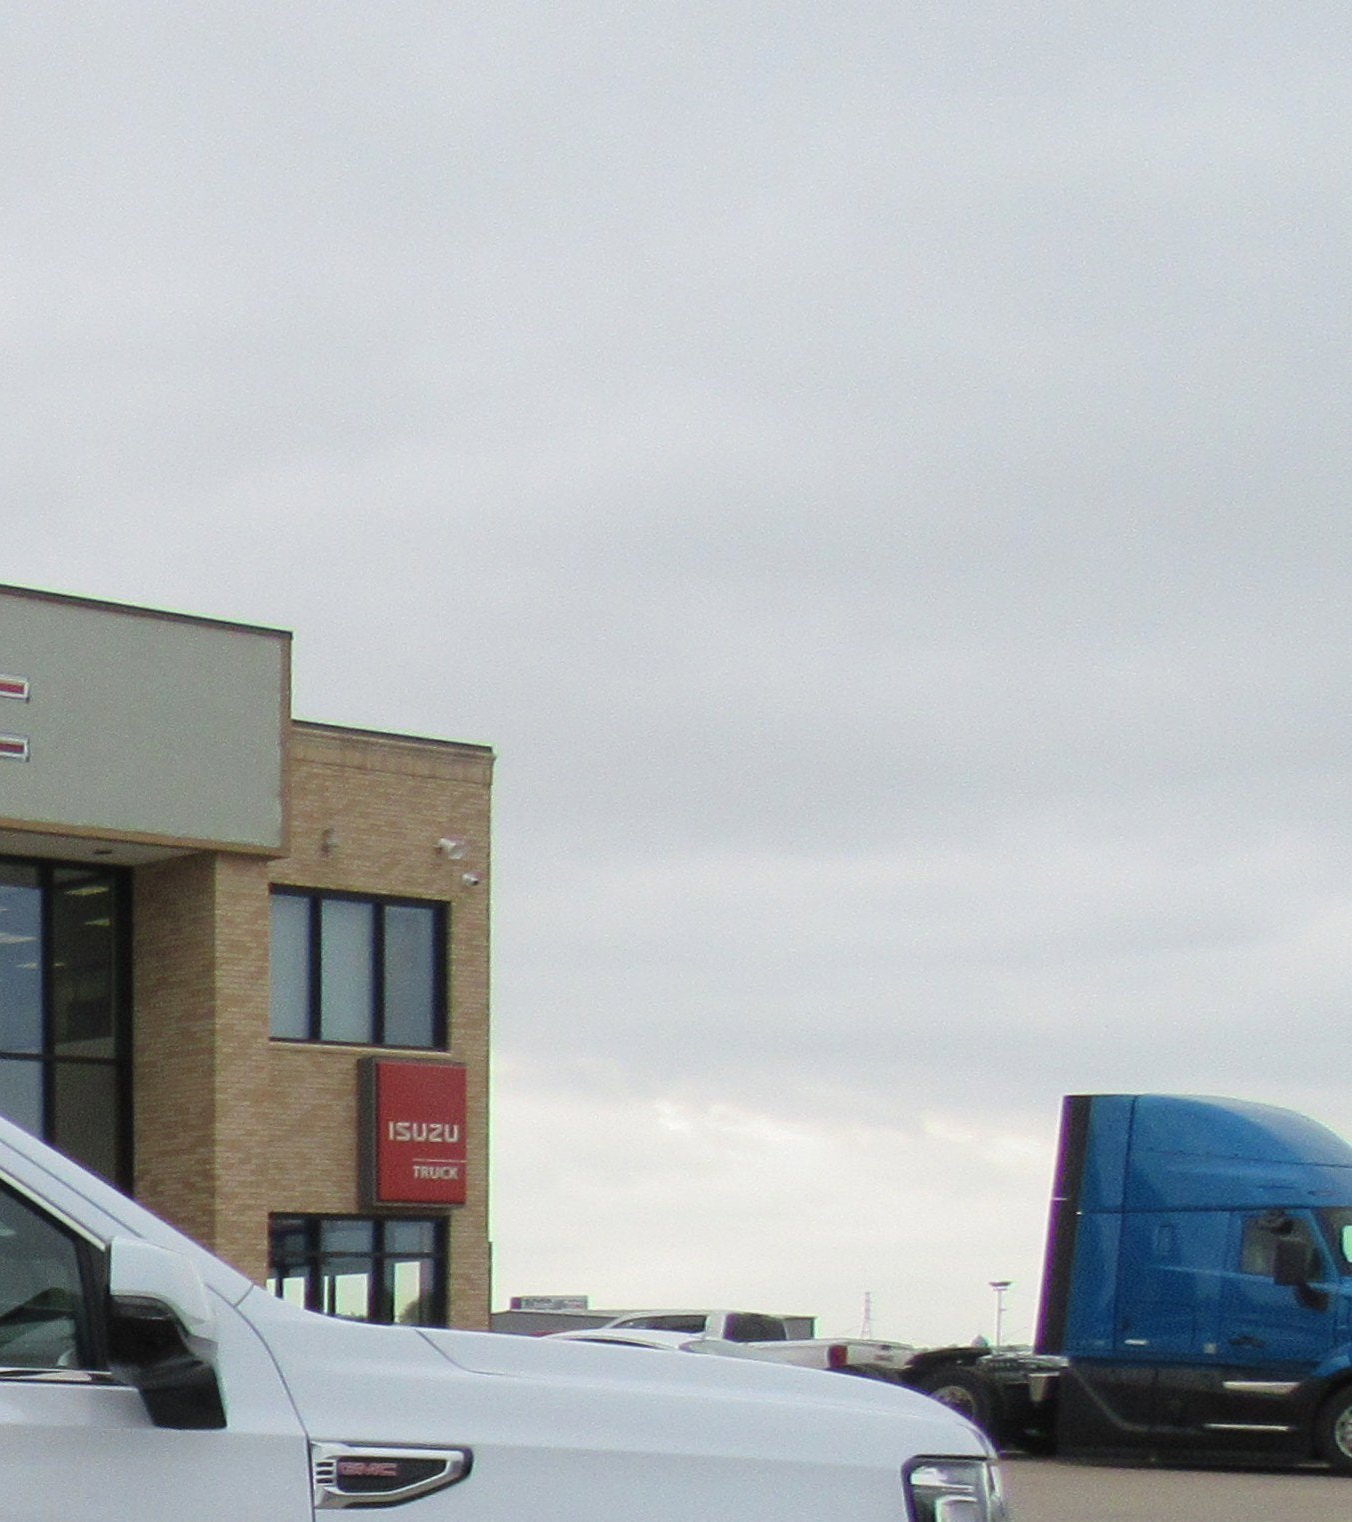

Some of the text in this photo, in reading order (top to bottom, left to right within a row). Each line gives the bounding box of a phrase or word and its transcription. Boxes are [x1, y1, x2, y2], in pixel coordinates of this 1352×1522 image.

[388, 1121, 459, 1143] ISUZU
[413, 1165, 459, 1180] TRUCK
[337, 1461, 399, 1477] GMC
